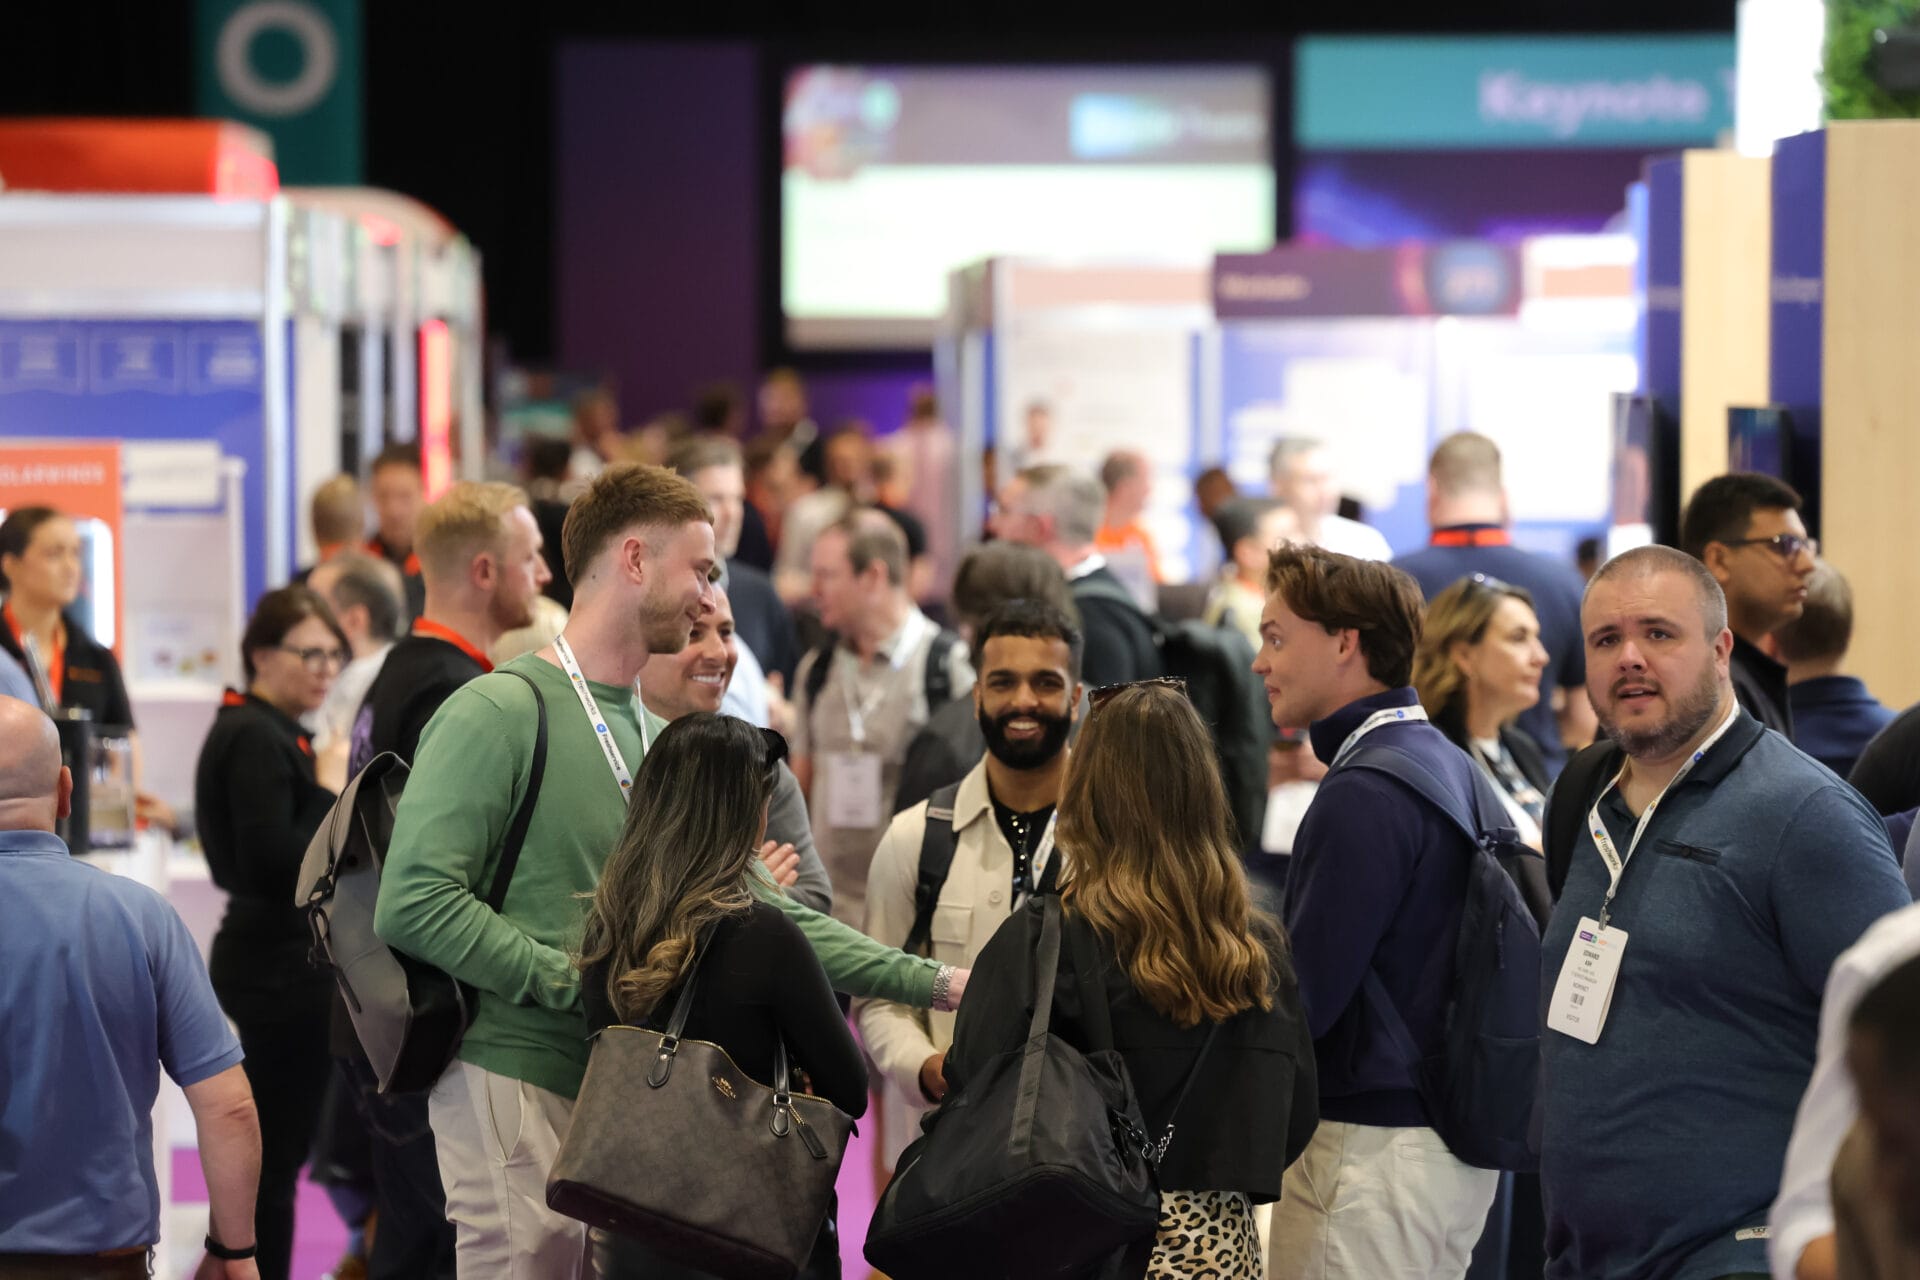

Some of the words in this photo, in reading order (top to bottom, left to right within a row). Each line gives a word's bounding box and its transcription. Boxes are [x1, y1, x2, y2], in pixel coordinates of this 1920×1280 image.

[1479, 69, 1710, 140] Keynote
[0, 462, 105, 486] OLARWINDS
[602, 733, 621, 771] Freshservice
[1600, 837, 1619, 870] freshworks
